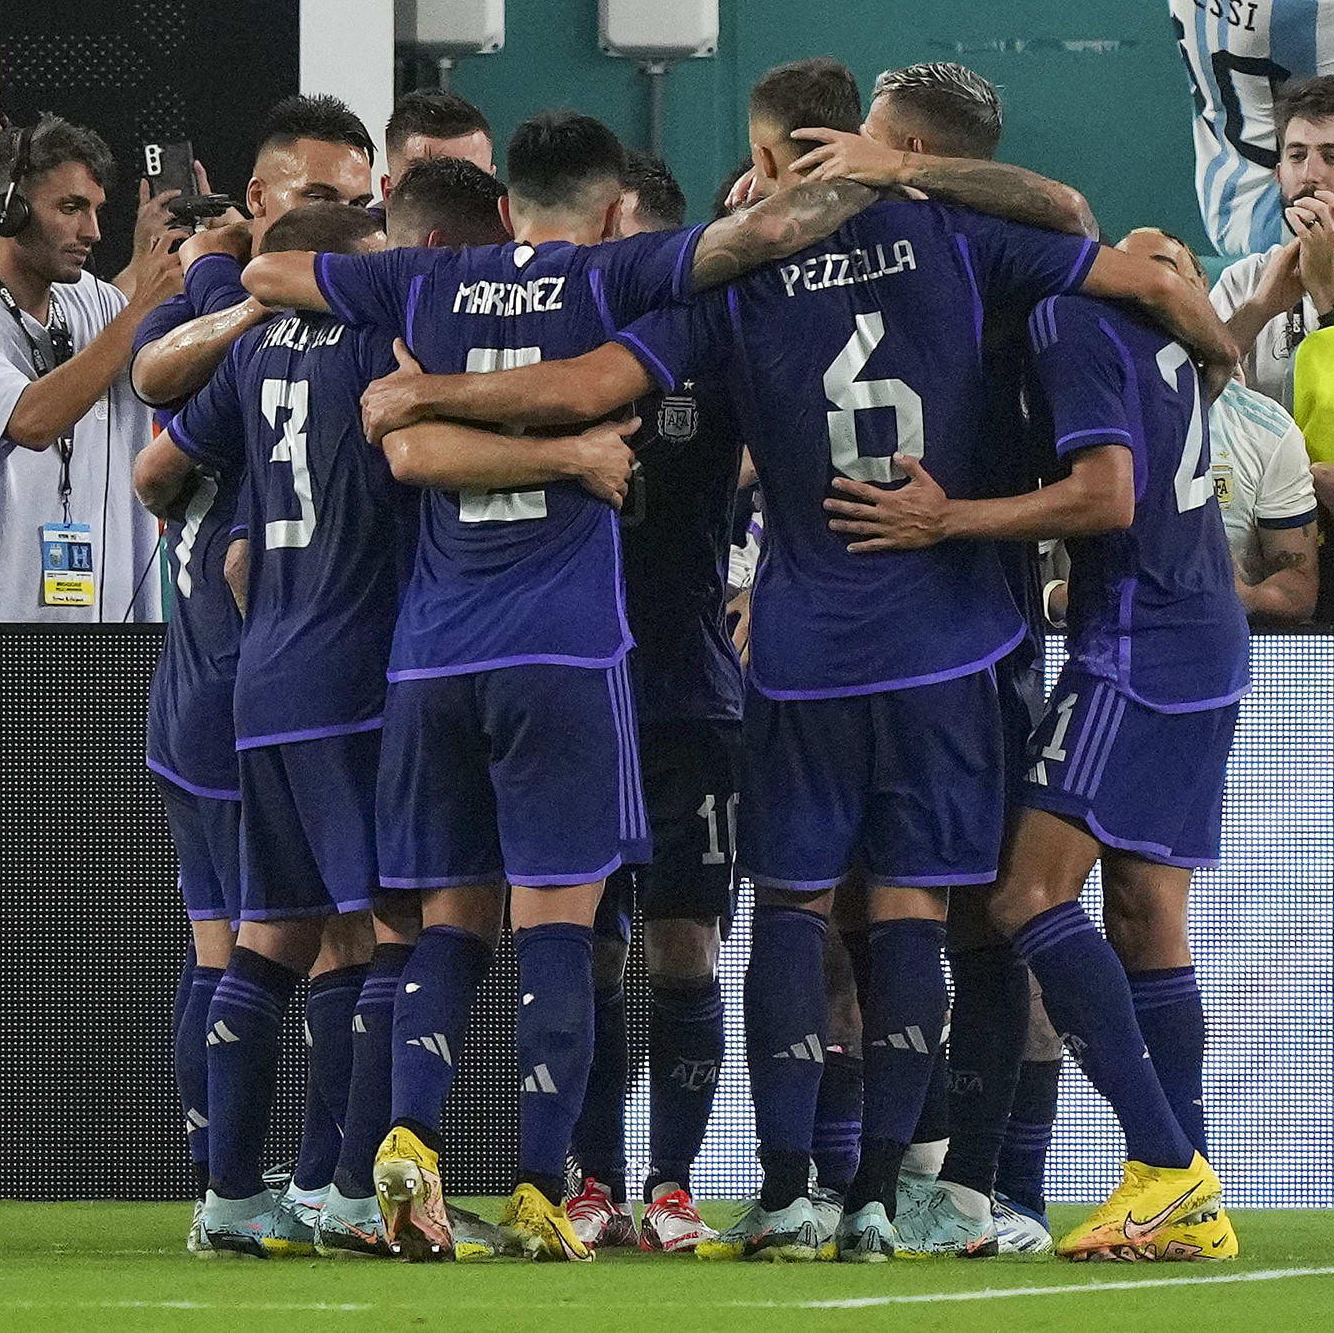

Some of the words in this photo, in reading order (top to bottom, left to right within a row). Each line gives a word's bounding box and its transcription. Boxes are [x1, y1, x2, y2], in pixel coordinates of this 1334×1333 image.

[779, 239, 917, 297] PEZZELLA
[260, 378, 317, 550] 3
[822, 310, 925, 484] 6
